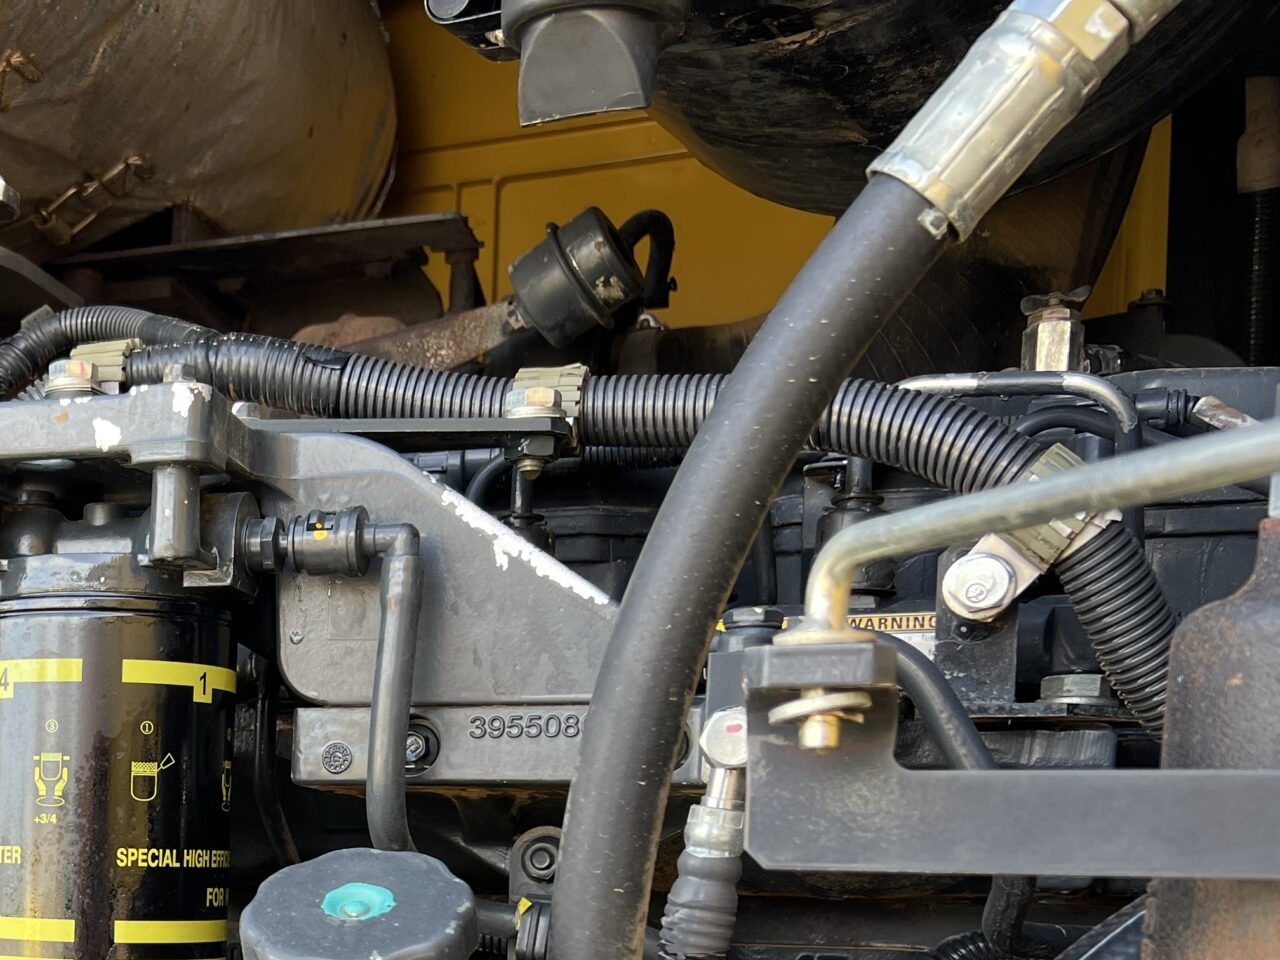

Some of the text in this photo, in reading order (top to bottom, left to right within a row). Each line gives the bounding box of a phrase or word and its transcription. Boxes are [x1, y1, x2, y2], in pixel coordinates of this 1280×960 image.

[199, 671, 208, 696] 1
[469, 713, 586, 738] 395508
[33, 813, 58, 824] +3/4
[116, 847, 180, 868] SPECIAL
[183, 849, 210, 868] HIGH
[206, 887, 225, 907] FOR
